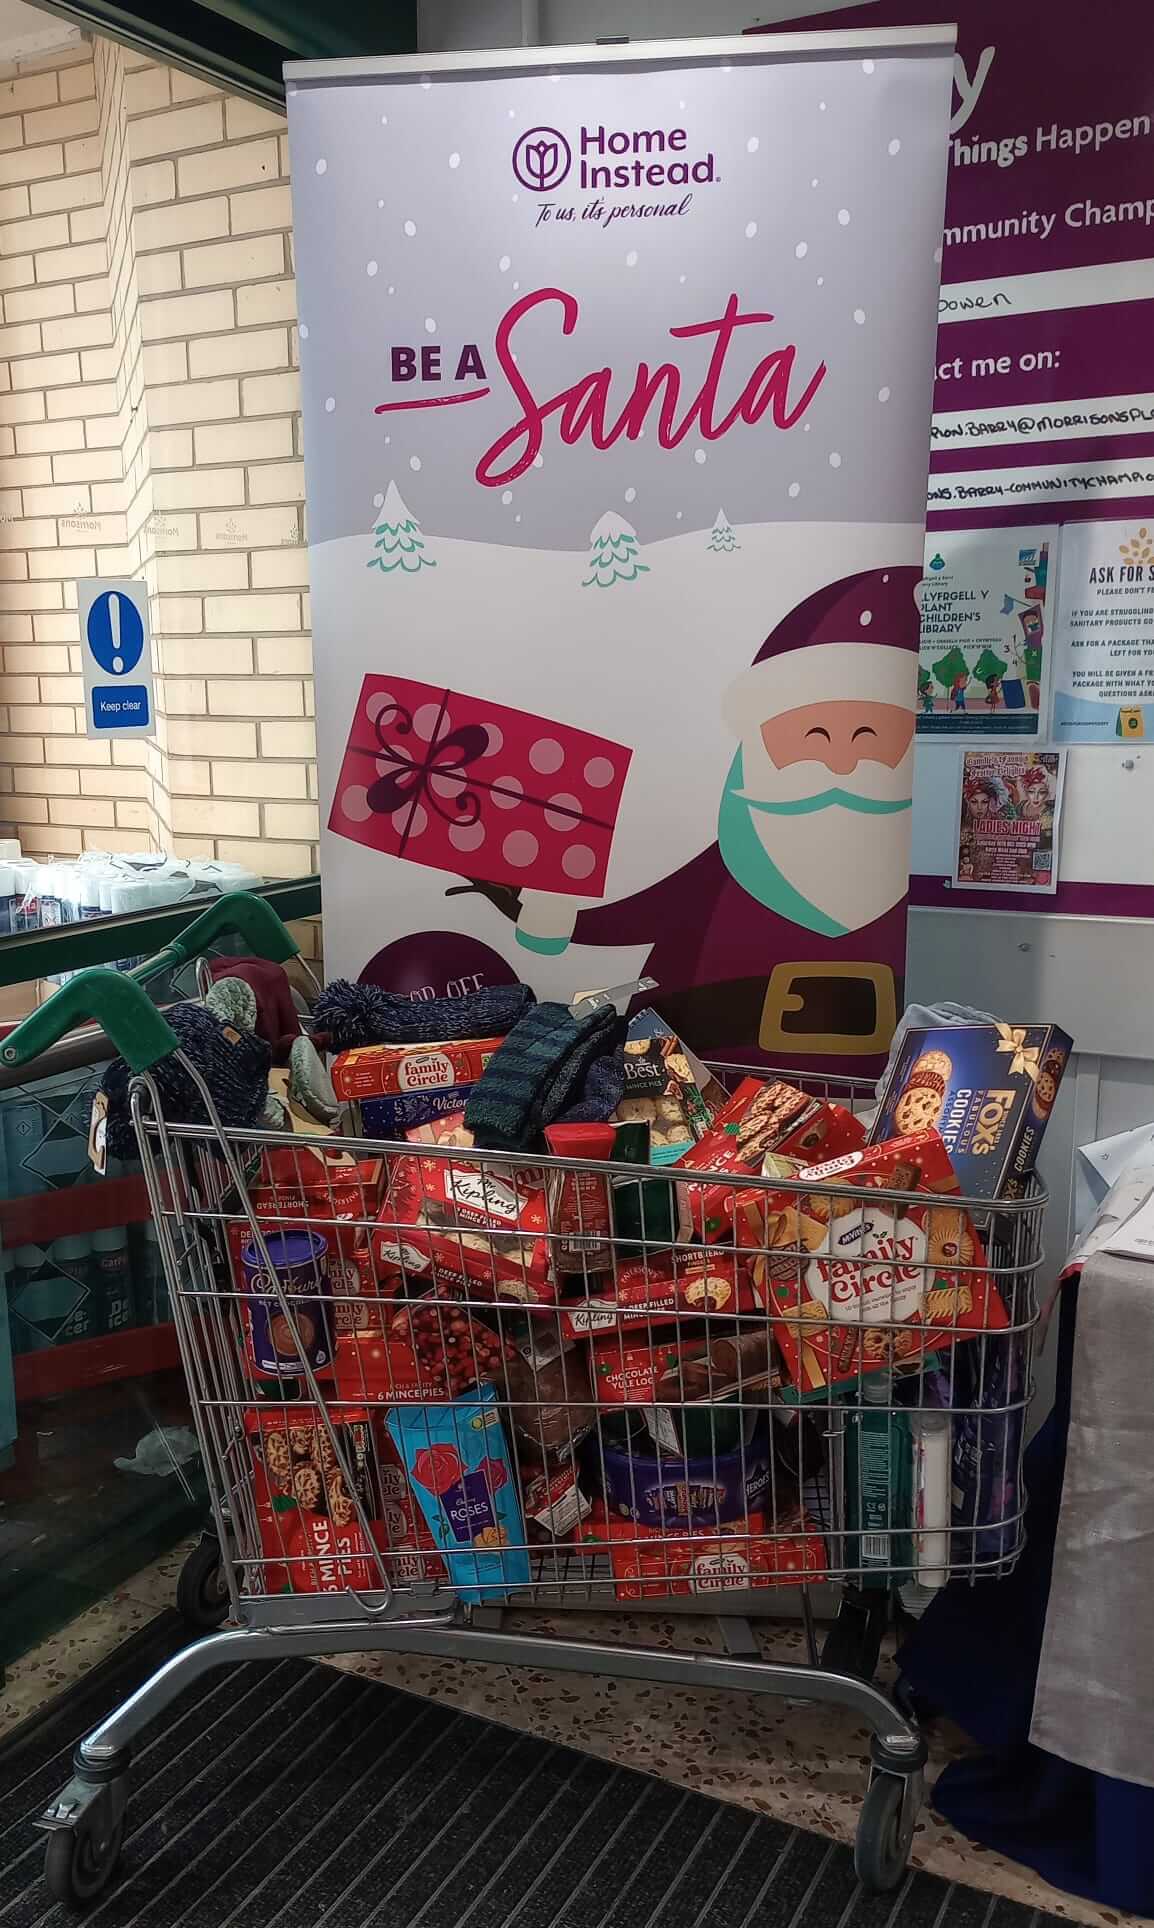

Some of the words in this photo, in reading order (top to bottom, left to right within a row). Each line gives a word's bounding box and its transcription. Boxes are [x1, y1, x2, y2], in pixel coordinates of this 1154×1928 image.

[580, 126, 687, 155] Home
[1036, 115, 1150, 154] Happen
[535, 203, 557, 227] To
[556, 207, 577, 221] us,
[581, 197, 606, 220] it's
[603, 193, 693, 228] personal
[972, 359, 1011, 377] me
[1019, 350, 1061, 371] on:
[390, 345, 441, 382] BE
[454, 344, 487, 380] A
[475, 287, 827, 487] Santa
[1089, 567, 1114, 584] ASK
[1120, 566, 1143, 583] FOR
[980, 590, 989, 599] Y
[1097, 588, 1123, 596] PLEASE
[1080, 609, 1093, 617] YOU
[1070, 619, 1103, 627] SANITARY
[1105, 618, 1141, 626] PRODUCTS
[1088, 670, 1103, 678] WILL
[1072, 680, 1104, 688] PACKAGE
[1125, 679, 1145, 687] WHAT
[100, 701, 120, 712] Keep
[122, 700, 141, 711] clear
[404, 1061, 449, 1077] family
[624, 1062, 660, 1079] Best
[407, 1074, 448, 1087] Circle
[1014, 1126, 1035, 1173] COOKIES
[450, 1179, 517, 1214] Kipling
[831, 1264, 920, 1303] Circle
[377, 1391, 385, 1400] 6
[386, 1389, 421, 1400] MINCE
[423, 1387, 445, 1397] PIES
[450, 1502, 490, 1521] ROSES
[313, 1520, 337, 1582] MINCE
[696, 1562, 745, 1576] family
